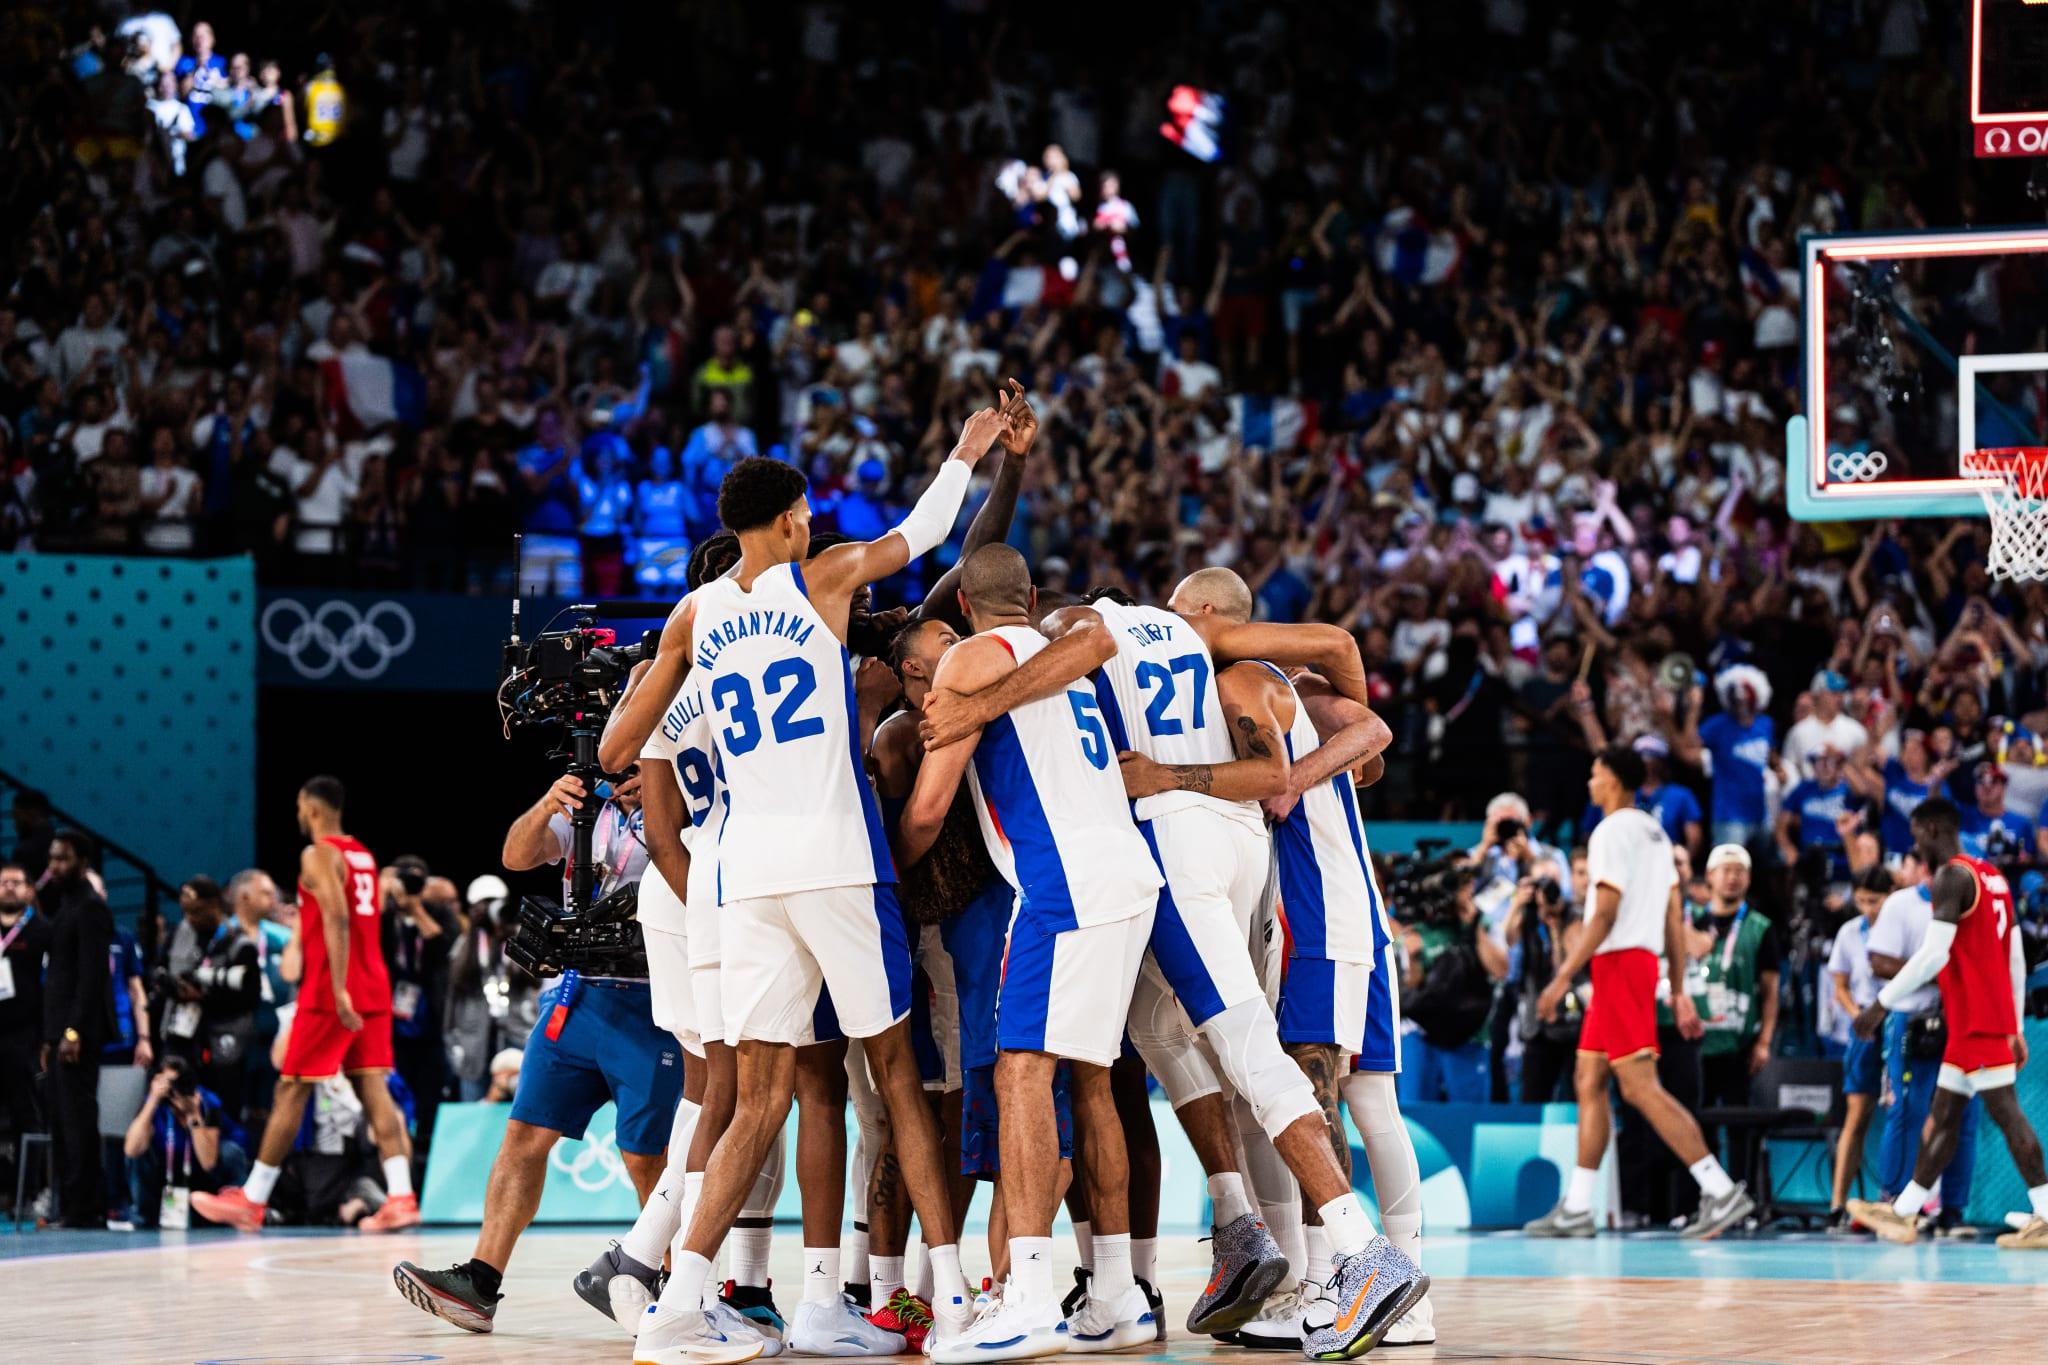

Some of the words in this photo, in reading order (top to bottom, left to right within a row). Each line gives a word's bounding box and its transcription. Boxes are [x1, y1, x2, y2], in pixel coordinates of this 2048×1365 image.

[697, 610, 816, 671] WEMBANYAMA
[711, 656, 825, 757] 32
[1067, 690, 1109, 770] 5
[1135, 653, 1209, 736] 27
